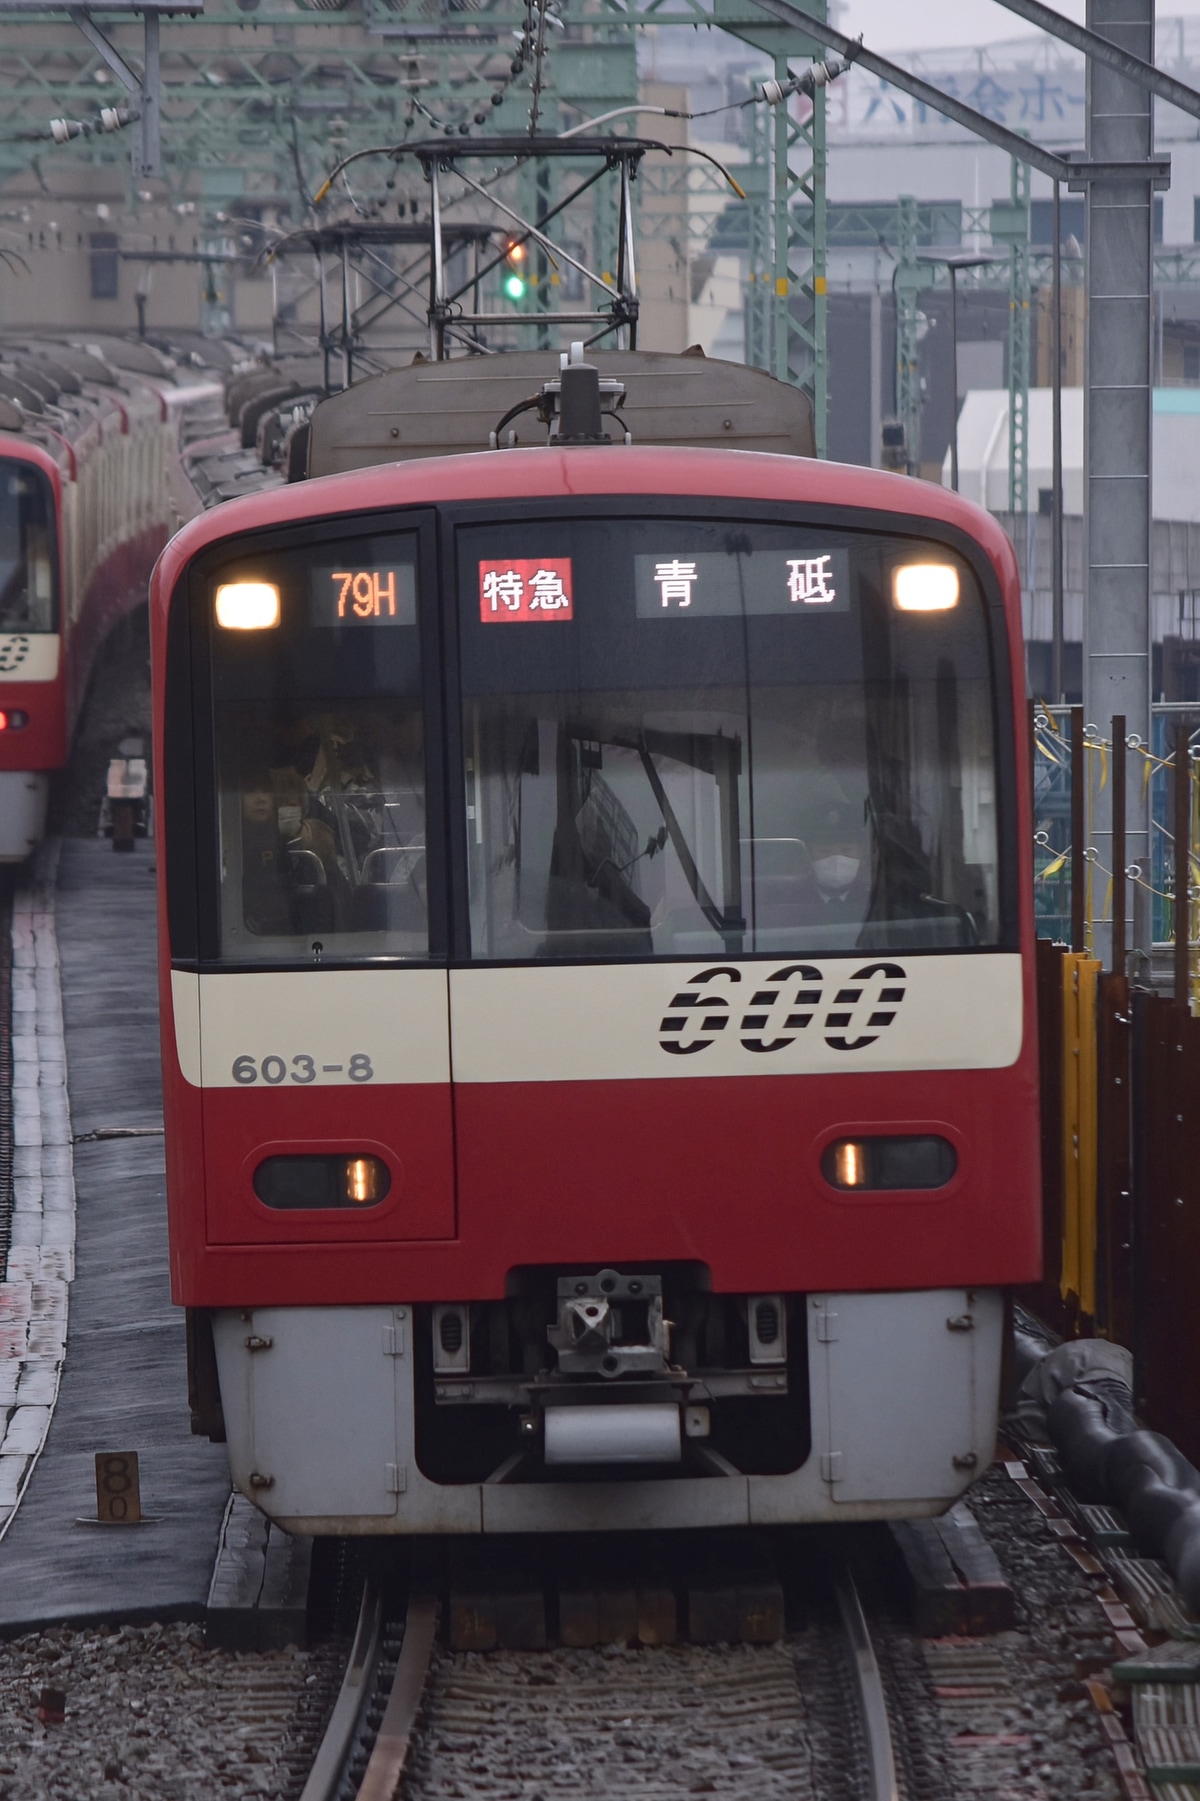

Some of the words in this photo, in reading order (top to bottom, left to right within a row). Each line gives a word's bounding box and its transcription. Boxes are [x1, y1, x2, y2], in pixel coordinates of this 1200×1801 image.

[332, 571, 396, 617] 79H
[482, 569, 569, 612] 特急
[659, 962, 907, 1055] 600
[231, 1053, 374, 1085] 603-8
